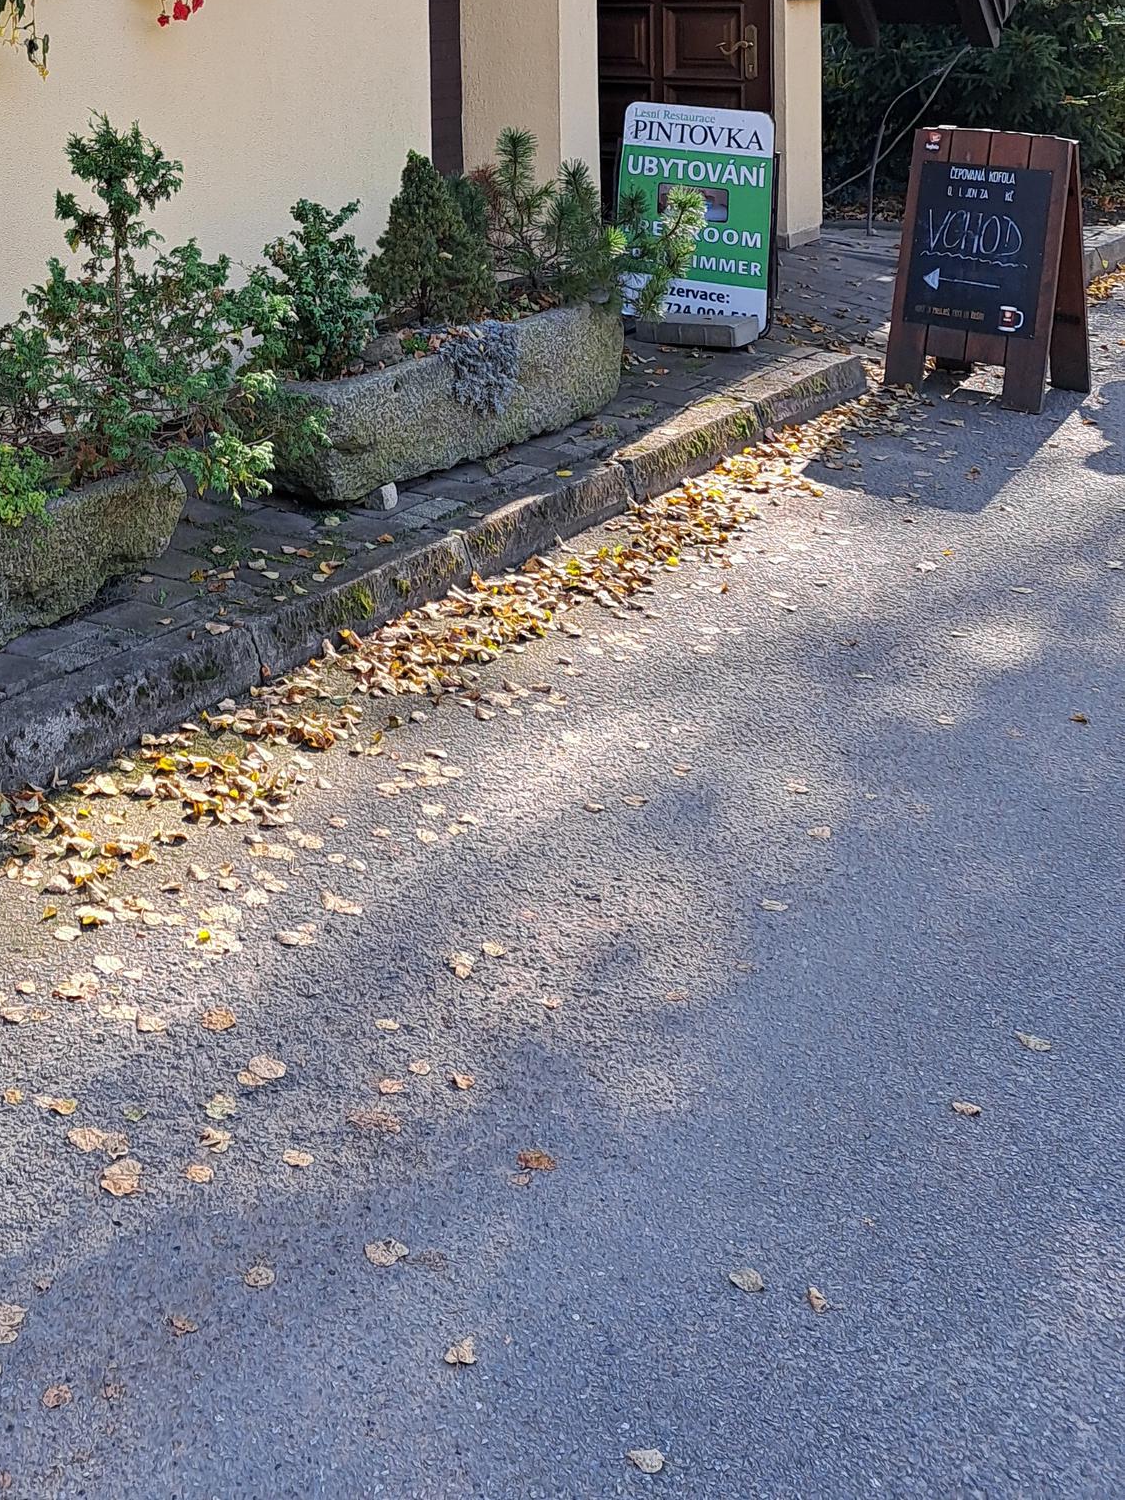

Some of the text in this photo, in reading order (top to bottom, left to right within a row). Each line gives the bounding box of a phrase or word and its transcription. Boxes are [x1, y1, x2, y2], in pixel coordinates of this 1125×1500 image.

[634, 107, 716, 123] Lesní Restaurace
[633, 119, 764, 151] PINTOVKA
[627, 153, 767, 188] UBYTOVÁNÍ
[950, 166, 1016, 185] ČEPOVANÁ KOFOLA
[979, 188, 989, 199] ZA
[928, 208, 1023, 256] VCHOD
[691, 254, 762, 277] IMMER
[663, 286, 731, 304] zervace:
